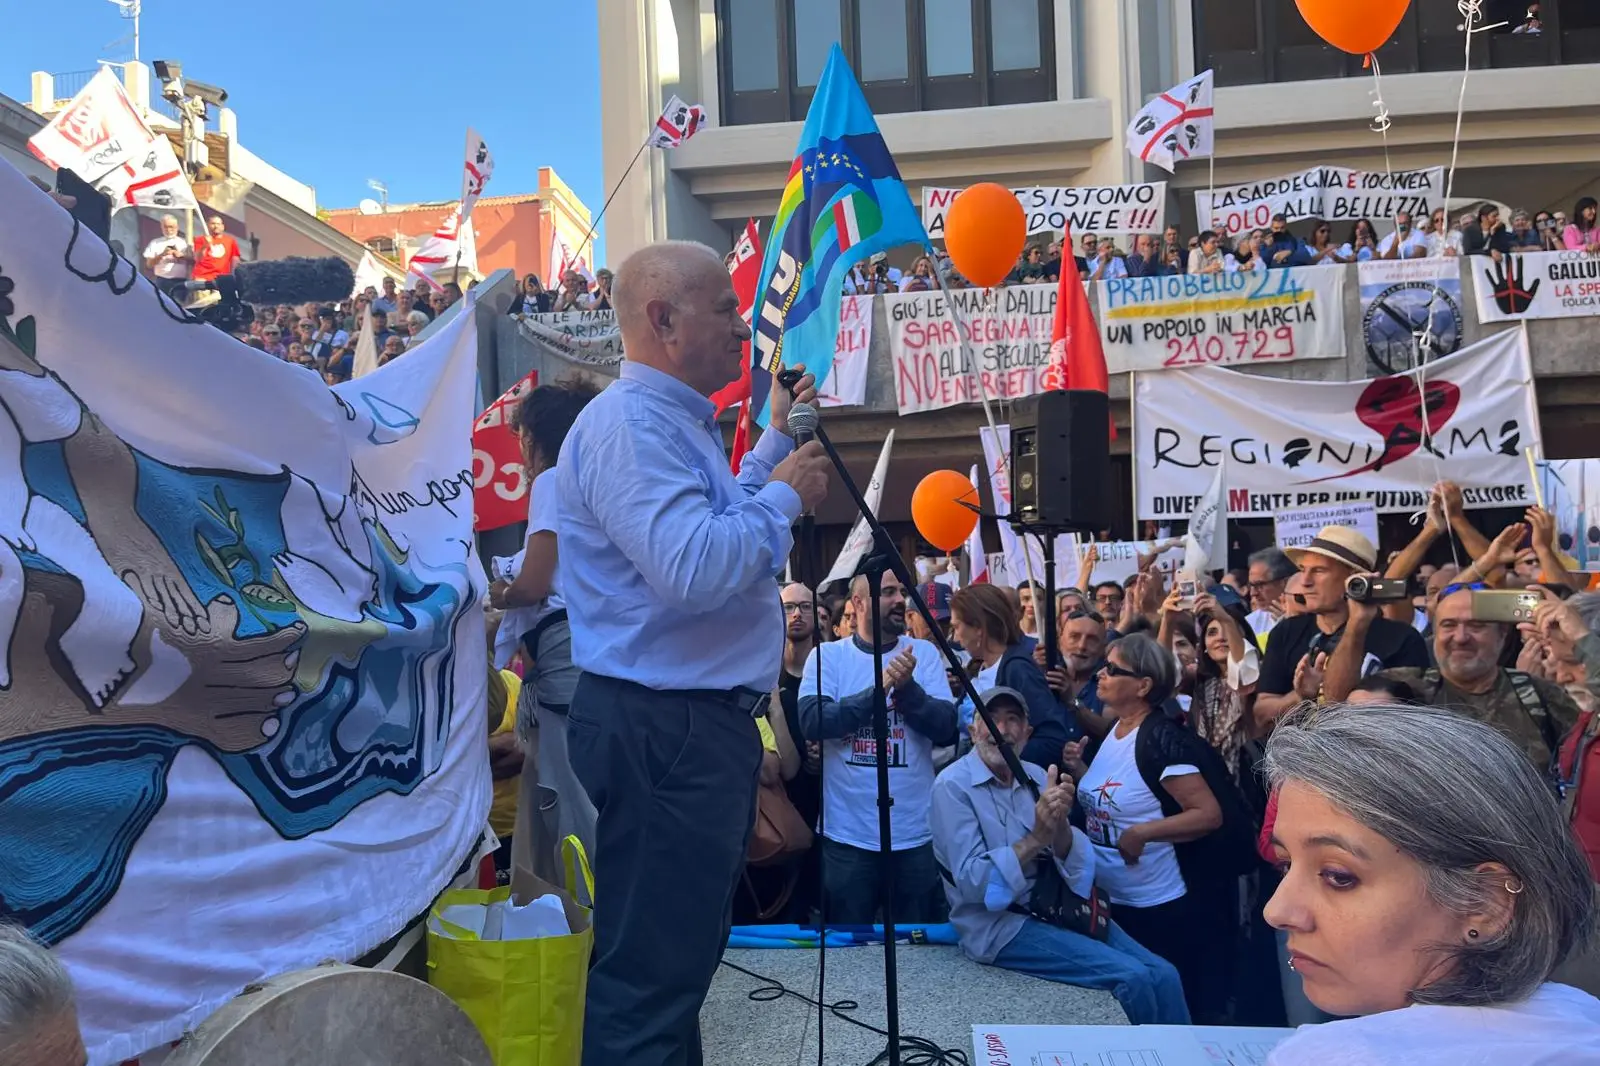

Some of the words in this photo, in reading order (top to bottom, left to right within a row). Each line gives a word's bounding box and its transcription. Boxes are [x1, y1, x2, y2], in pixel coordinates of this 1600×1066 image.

[1014, 185, 1155, 208] SISTONO
[1237, 168, 1343, 204] SARDEGNA
[1283, 196, 1324, 218] ALLA
[1024, 209, 1120, 233] DONEE
[1548, 260, 1600, 281] GALLU
[1107, 270, 1246, 307] PRATOBELLO
[1554, 284, 1574, 298] LA
[1107, 324, 1133, 345] UN
[1143, 317, 1206, 342] POPOLO
[1163, 325, 1295, 367] 210.729
[898, 352, 938, 407] NO
